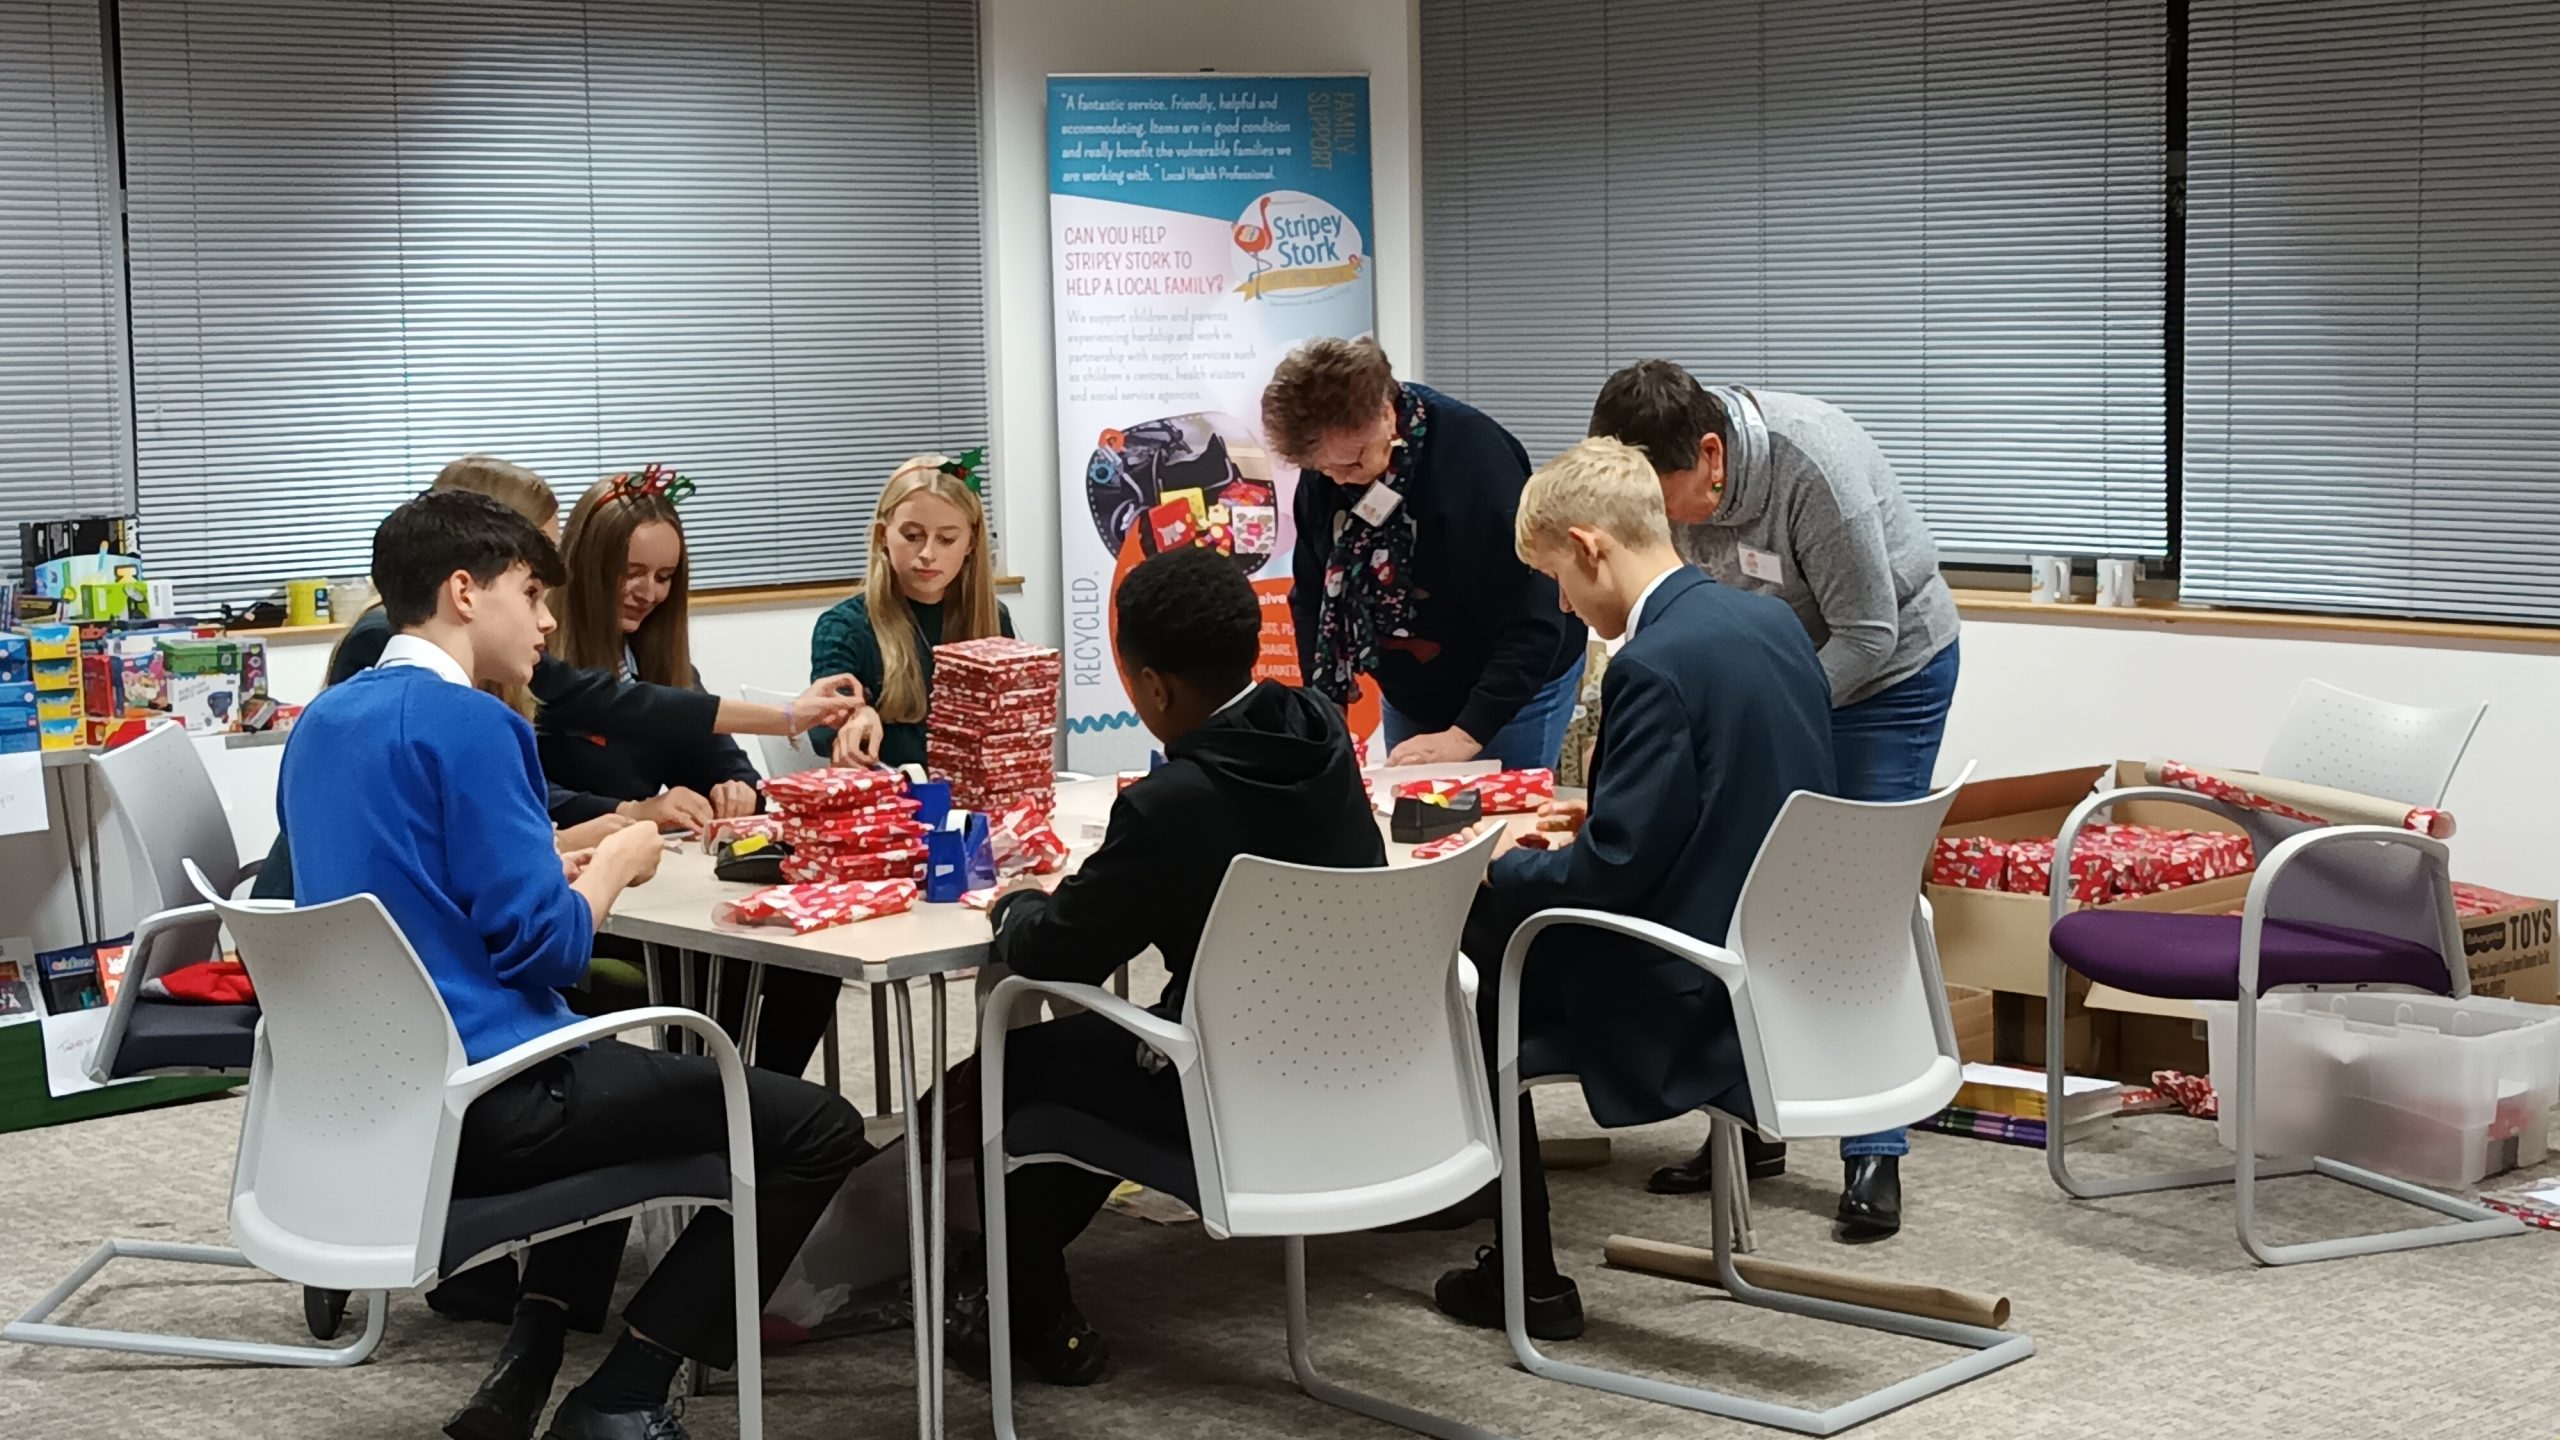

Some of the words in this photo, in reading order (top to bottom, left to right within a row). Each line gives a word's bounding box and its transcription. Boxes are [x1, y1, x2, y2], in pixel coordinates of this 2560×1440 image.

[1078, 93, 1124, 110] fantastic
[1219, 92, 1256, 113] helpful
[1258, 92, 1278, 109] and
[1149, 118, 1179, 133] Items
[1182, 124, 1199, 134] are
[1202, 121, 1212, 133] in
[1214, 116, 1239, 137] good
[1242, 116, 1290, 133] condition
[1307, 91, 1332, 170] SUPPORT
[1334, 92, 1357, 156] FAMILY
[1062, 141, 1082, 158] and
[1084, 141, 1114, 162] really
[1116, 140, 1153, 158] benefit
[1156, 140, 1174, 158] the
[1176, 140, 1230, 157] vulnerable
[1234, 139, 1274, 156] families
[1277, 147, 1291, 156] we
[1062, 173, 1080, 182] are
[1082, 165, 1124, 186] working
[1161, 166, 1185, 181] Local
[1187, 166, 1217, 180] Health
[1064, 227, 1094, 245] CAN
[1097, 226, 1128, 245] YOU
[1132, 226, 1167, 244] HELP
[1273, 214, 1342, 242] Stripey
[1065, 252, 1122, 270] STRIPEY
[1125, 251, 1171, 270] STORK
[1174, 250, 1192, 269] TO
[1278, 236, 1340, 267] Stork
[1066, 277, 1101, 296] HELP
[1104, 277, 1114, 295] A
[1117, 277, 1161, 295] LOCAL
[1164, 274, 1224, 294] FAMILY?
[1066, 309, 1086, 323] We
[1089, 314, 1126, 326] support
[1129, 307, 1168, 322] children
[1171, 307, 1189, 322] and
[1191, 313, 1228, 325] parents
[1068, 333, 1129, 346] experiencing
[1132, 326, 1174, 344] hardship
[1176, 326, 1194, 341] and
[1197, 325, 1220, 340] work
[1223, 331, 1233, 339] in
[1069, 346, 1125, 366] partnership
[1127, 346, 1148, 361] with
[1152, 351, 1188, 365] support
[1192, 351, 1231, 360] services
[1234, 344, 1256, 360] such
[1069, 374, 1079, 382] as
[1176, 364, 1206, 380] health
[1210, 369, 1245, 379] visitors
[1070, 386, 1087, 401] and
[1091, 385, 1118, 401] social
[1121, 390, 1155, 401] service
[1072, 571, 1101, 686] RECYCLED.
[2509, 908, 2552, 951] TOYS
